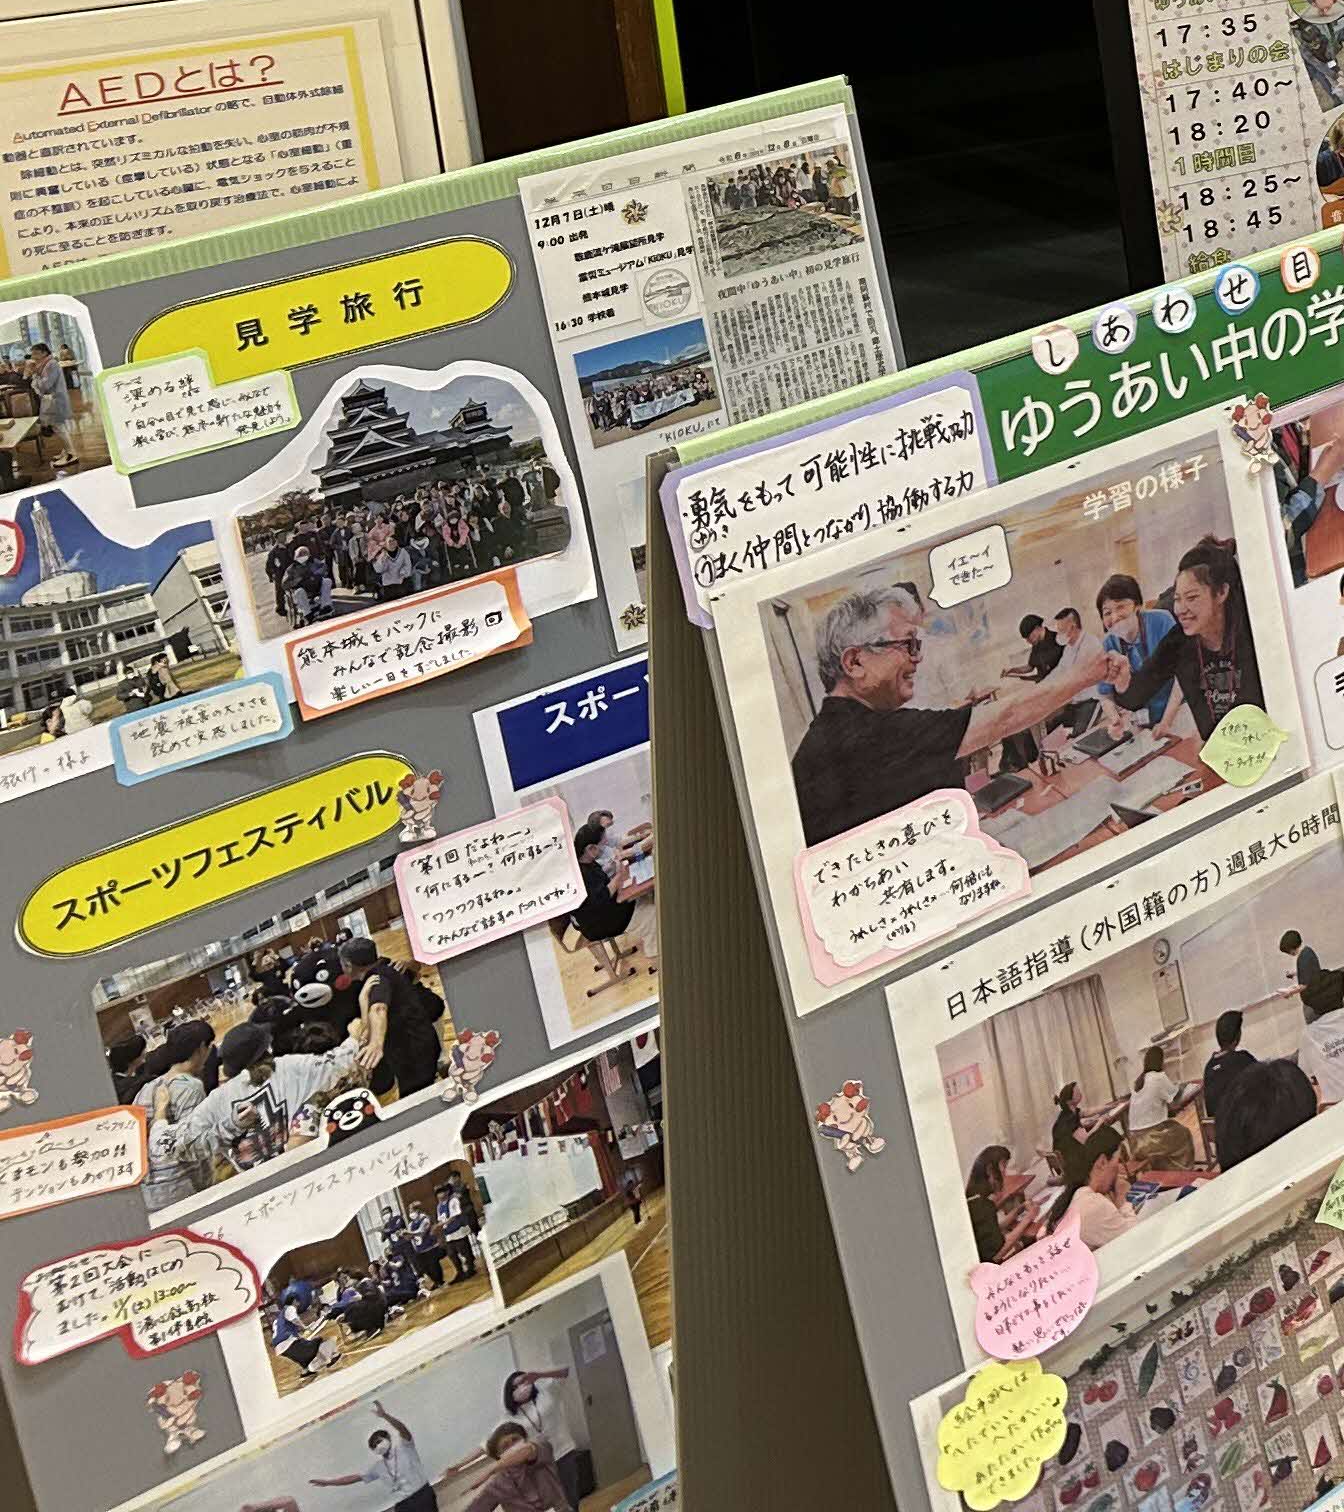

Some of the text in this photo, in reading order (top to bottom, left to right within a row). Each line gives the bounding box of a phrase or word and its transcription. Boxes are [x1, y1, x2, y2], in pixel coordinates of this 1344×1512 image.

[1155, 13, 1259, 48] 17:35
[1161, 40, 1291, 81] はじまりの会
[57, 53, 277, 112] AEDとは?
[12, 121, 86, 144] Automated
[87, 114, 139, 133] External
[1168, 110, 1272, 146] 18:20
[1182, 206, 1283, 244] 18:45
[236, 277, 425, 352] 見学旅行
[1082, 452, 1210, 522] 学習の様子
[51, 779, 394, 931] スポーツフェスティバル
